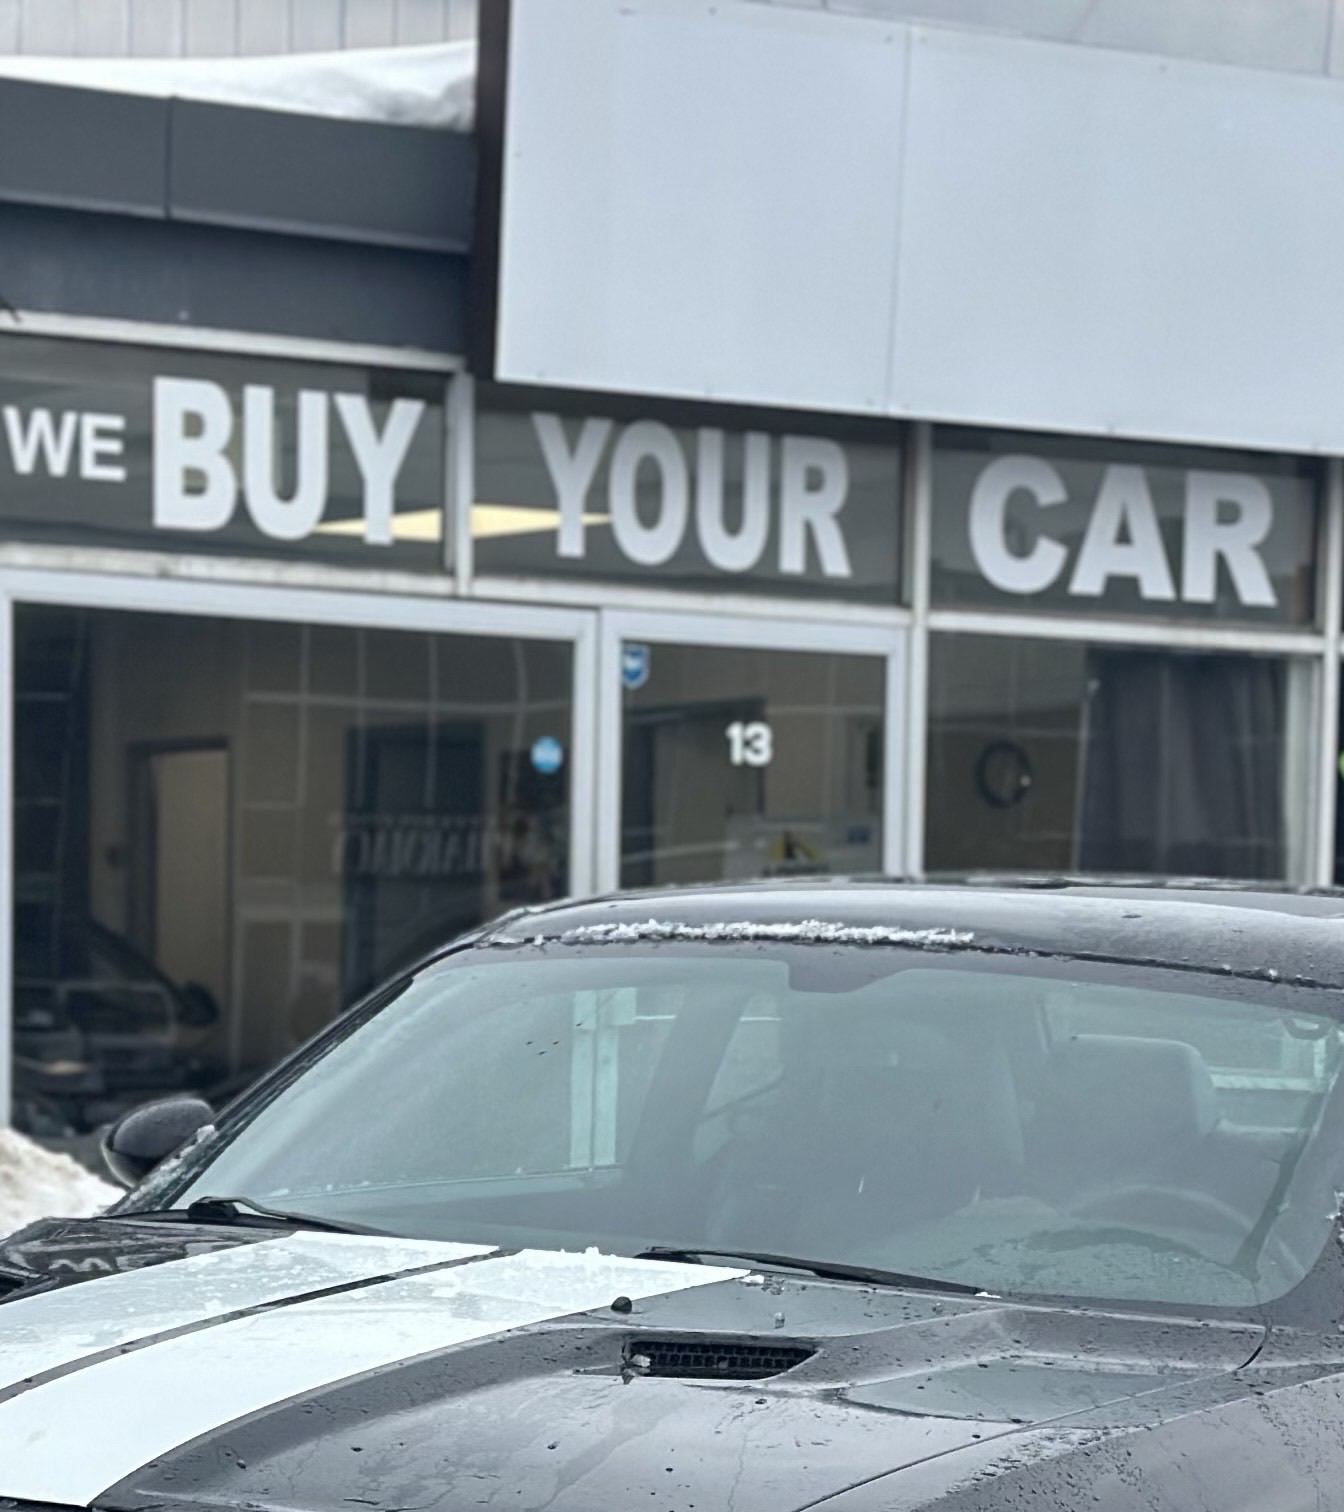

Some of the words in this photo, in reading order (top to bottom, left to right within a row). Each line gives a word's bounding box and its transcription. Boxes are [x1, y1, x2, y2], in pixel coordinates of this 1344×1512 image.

[2, 404, 127, 482] WE
[153, 375, 425, 546] BUY
[532, 411, 852, 578] YOUR
[968, 454, 1278, 607] CAR
[724, 721, 774, 767] 13
